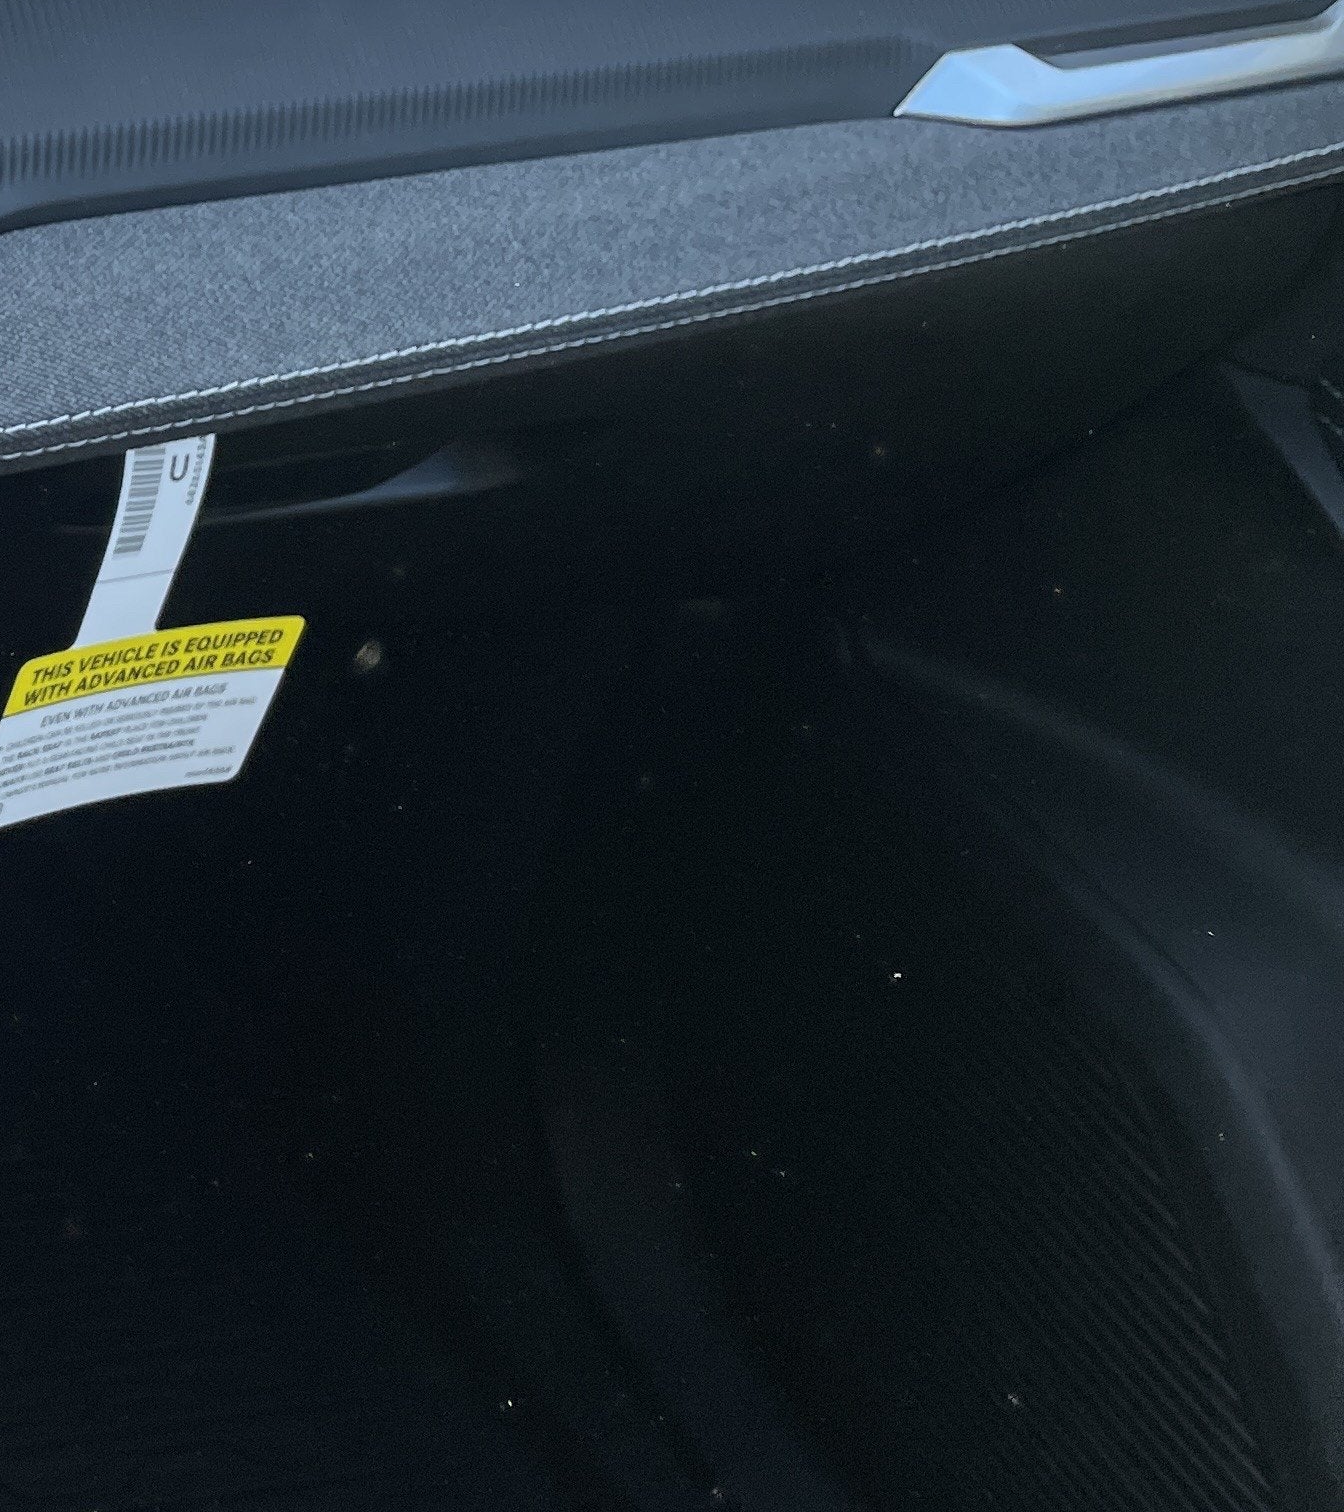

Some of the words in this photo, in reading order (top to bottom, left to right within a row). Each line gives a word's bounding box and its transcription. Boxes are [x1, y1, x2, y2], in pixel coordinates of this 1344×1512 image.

[170, 453, 190, 482] U
[23, 680, 73, 708] WITH
[74, 658, 181, 695] ADVANCED
[184, 654, 218, 676] AIR
[221, 648, 276, 670] BAGS
[32, 661, 74, 685] THIS
[79, 642, 157, 675] VEHICLE
[161, 638, 182, 657] IS
[185, 628, 284, 656] EQUIPPED
[40, 710, 72, 729] EVEN
[73, 704, 104, 723] WITH
[105, 693, 170, 716] ADVANCED
[170, 687, 193, 702] AIR
